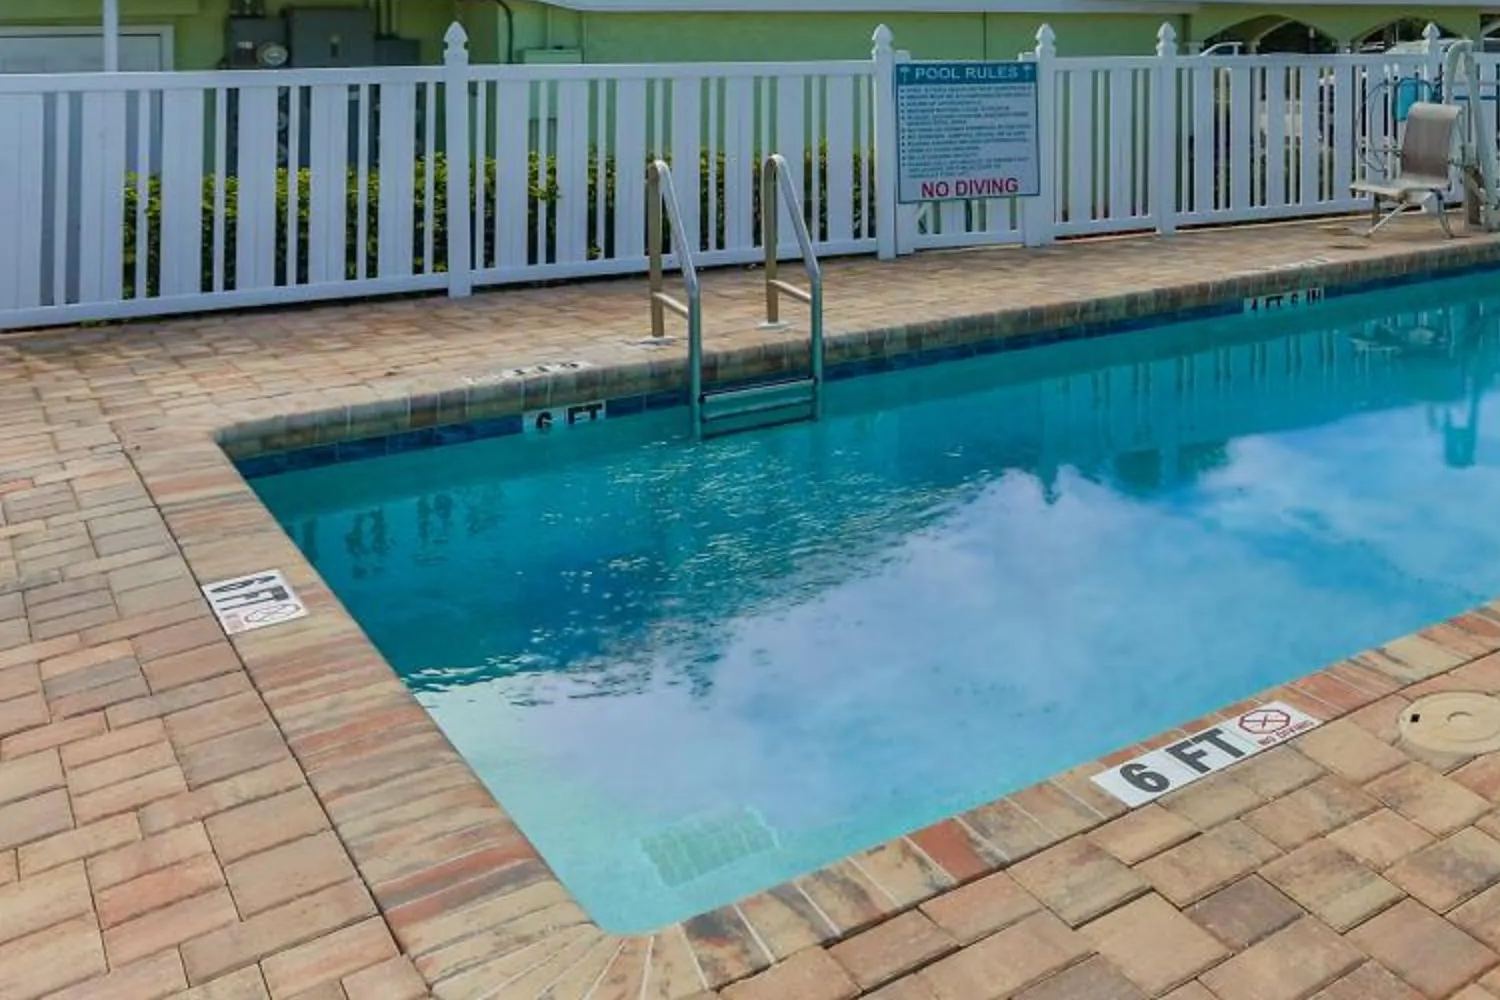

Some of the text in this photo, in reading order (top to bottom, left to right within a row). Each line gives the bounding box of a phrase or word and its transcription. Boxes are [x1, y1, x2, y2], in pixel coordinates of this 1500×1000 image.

[915, 66, 1019, 80] POOL RULES
[921, 177, 1019, 198] NO DIVING
[567, 403, 603, 425] FT
[215, 584, 289, 611] FT
[1119, 727, 1246, 793] 6 FT
